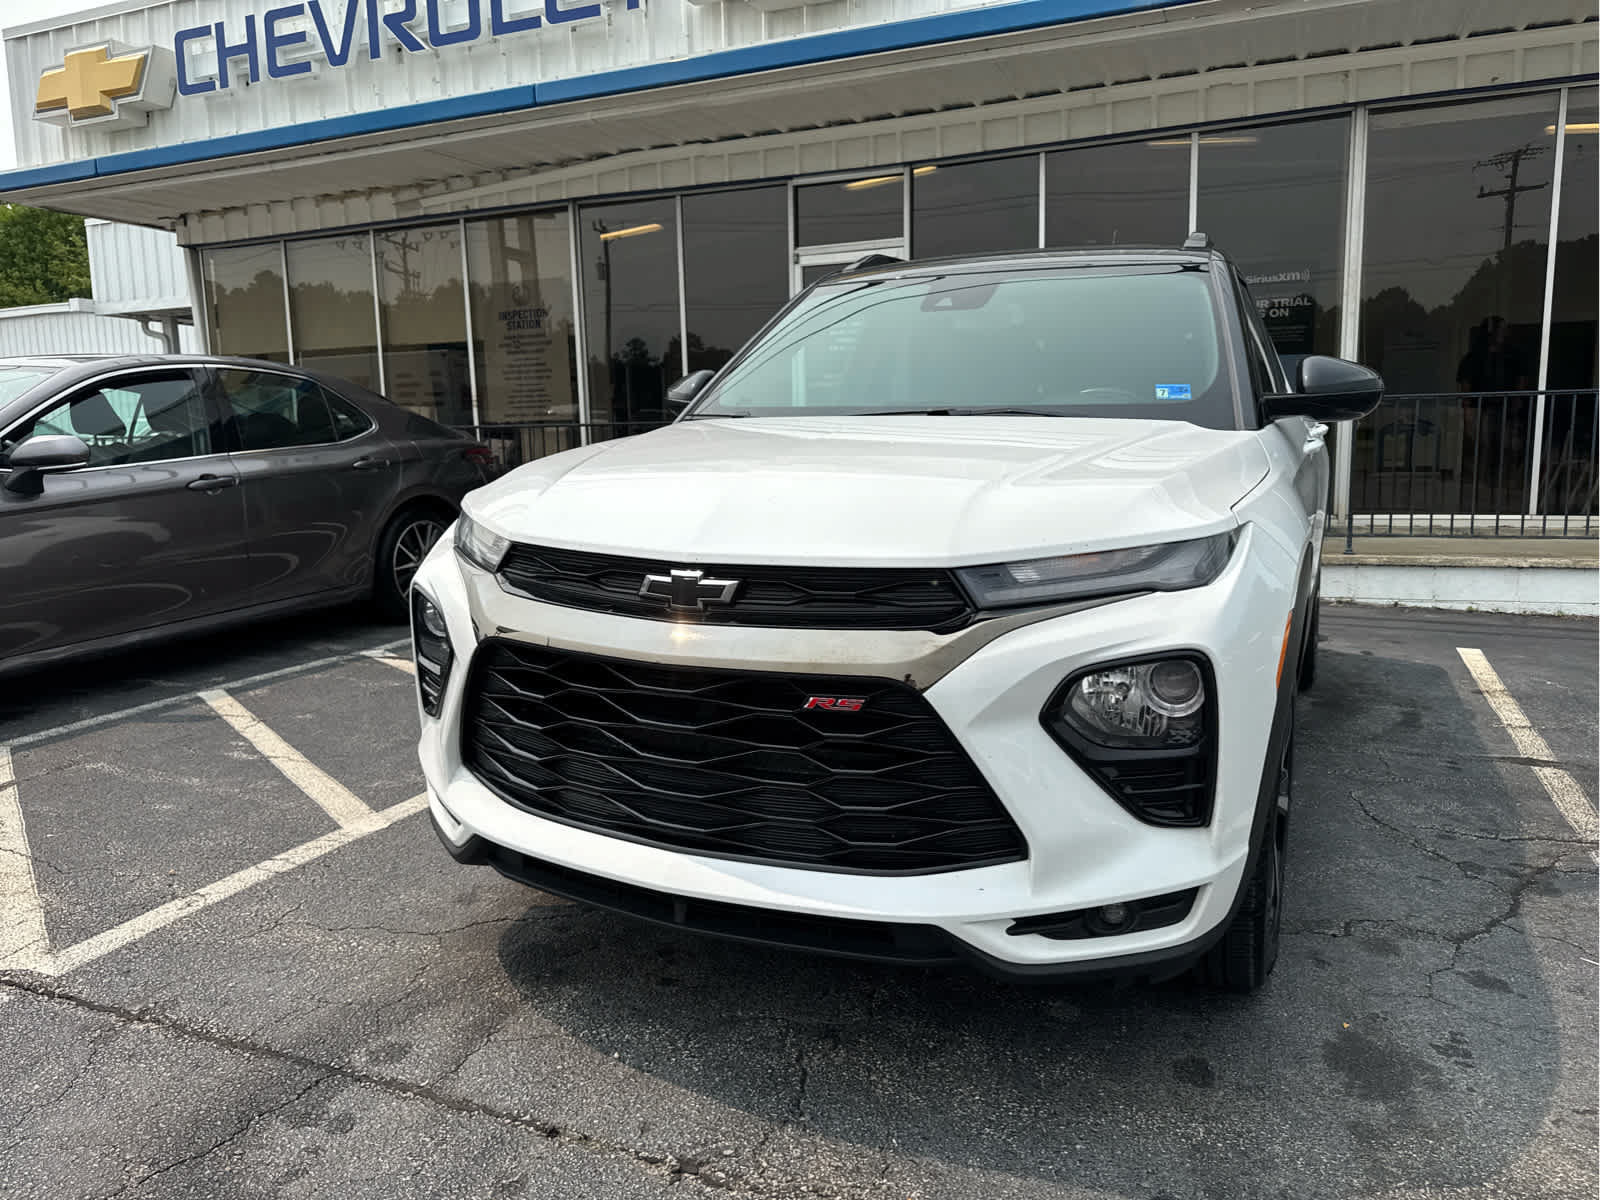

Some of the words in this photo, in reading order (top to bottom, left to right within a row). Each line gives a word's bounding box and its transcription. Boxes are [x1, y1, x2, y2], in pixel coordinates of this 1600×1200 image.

[174, 0, 640, 97] CHEVROL
[1271, 296, 1312, 307] TRIAL
[498, 308, 548, 320] INSPECTION
[1269, 308, 1289, 318] ON
[506, 320, 541, 329] STATION
[803, 696, 866, 712] RS
